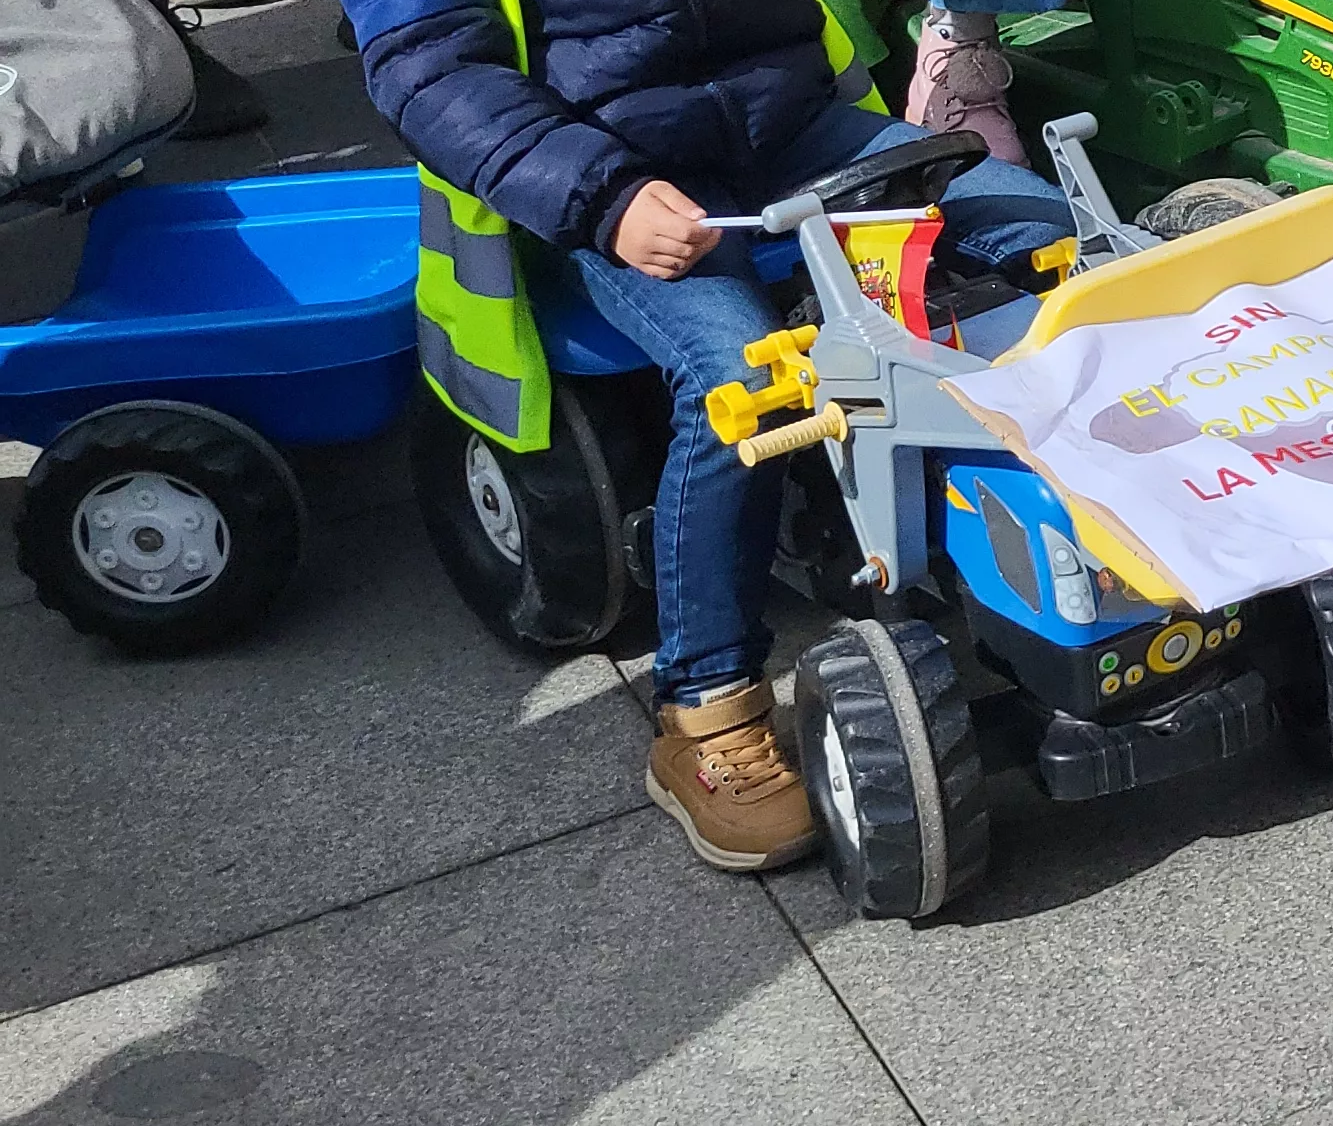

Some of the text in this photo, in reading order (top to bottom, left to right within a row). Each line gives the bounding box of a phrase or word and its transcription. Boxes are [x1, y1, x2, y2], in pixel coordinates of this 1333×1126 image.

[1205, 301, 1287, 345] SIN
[1121, 383, 1188, 418] EL
[1181, 467, 1258, 502] LA
